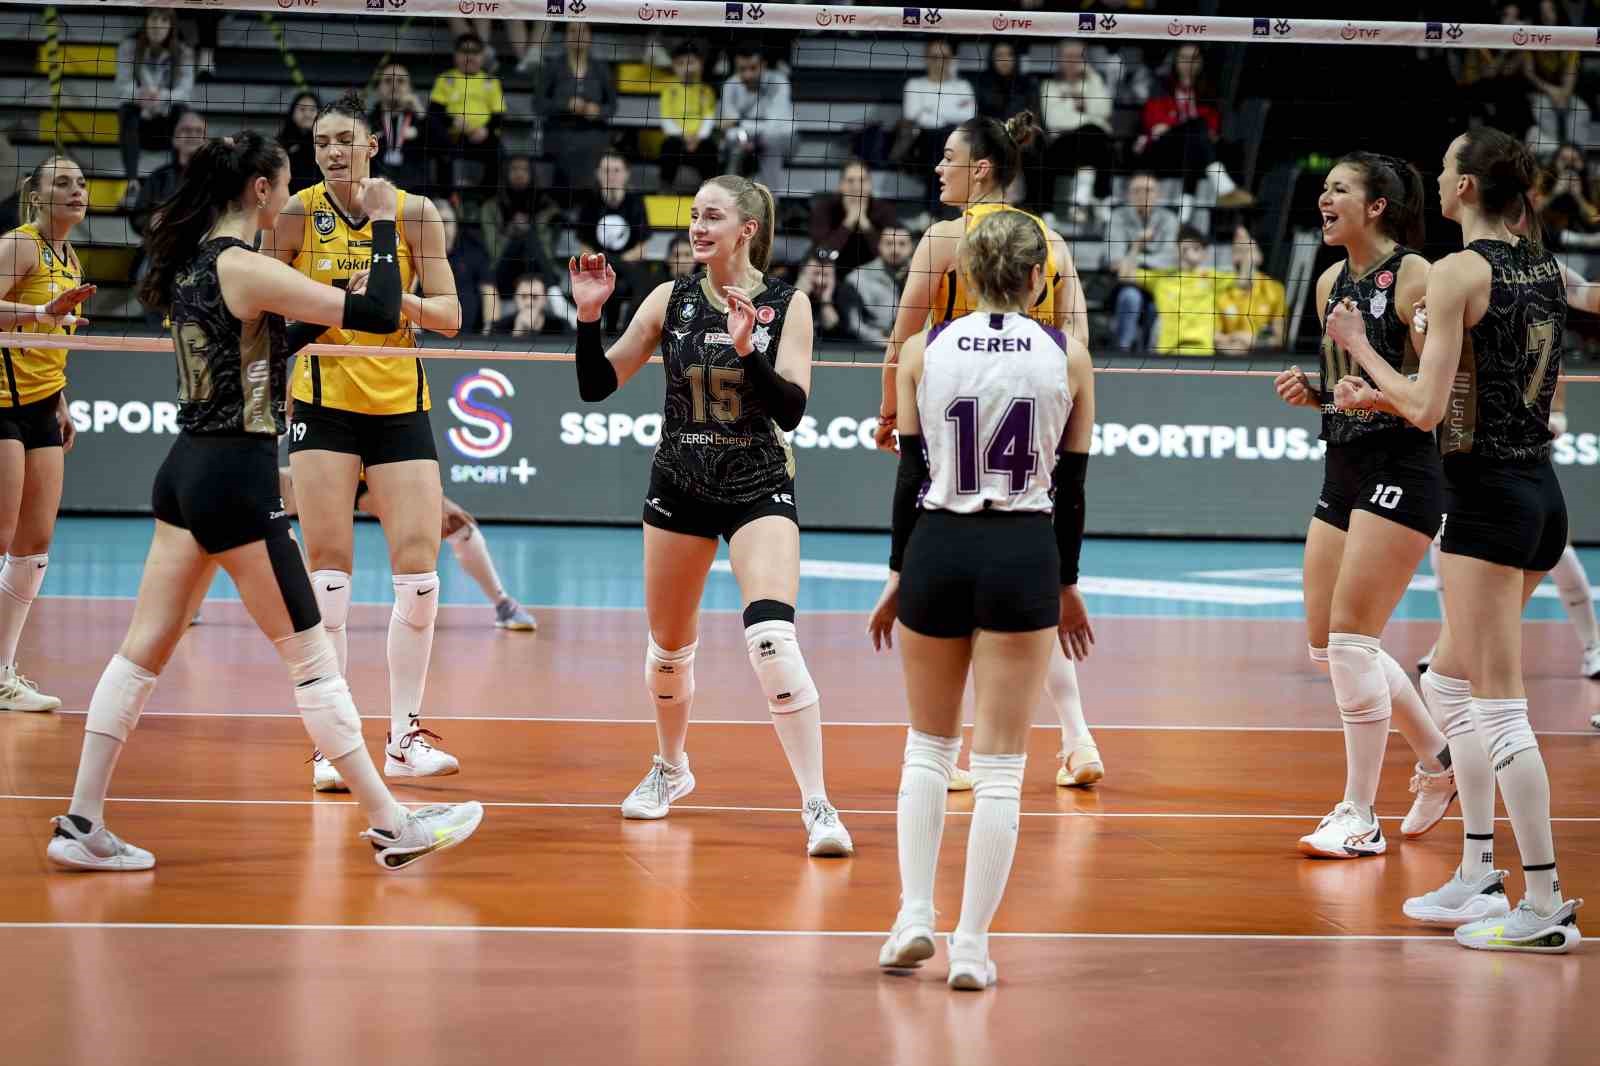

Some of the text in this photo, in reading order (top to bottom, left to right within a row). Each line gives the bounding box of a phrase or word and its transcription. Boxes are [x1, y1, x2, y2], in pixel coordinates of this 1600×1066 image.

[477, 3, 499, 12] TVF
[655, 9, 679, 19] TVF
[834, 14, 857, 24] TVF
[1011, 20, 1032, 29] TVF
[1185, 24, 1207, 34] TVF
[1358, 29, 1380, 39] TVF
[1531, 33, 1552, 43] TVF
[957, 336, 1032, 353] CEREN
[1524, 318, 1555, 409] 7
[683, 364, 745, 425] 15
[69, 400, 181, 434] SPOR
[292, 422, 307, 442] 19
[680, 432, 753, 448] ZEREN Energy
[945, 396, 1039, 496] 14
[1552, 431, 1600, 466] SS
[1369, 483, 1403, 510] 10
